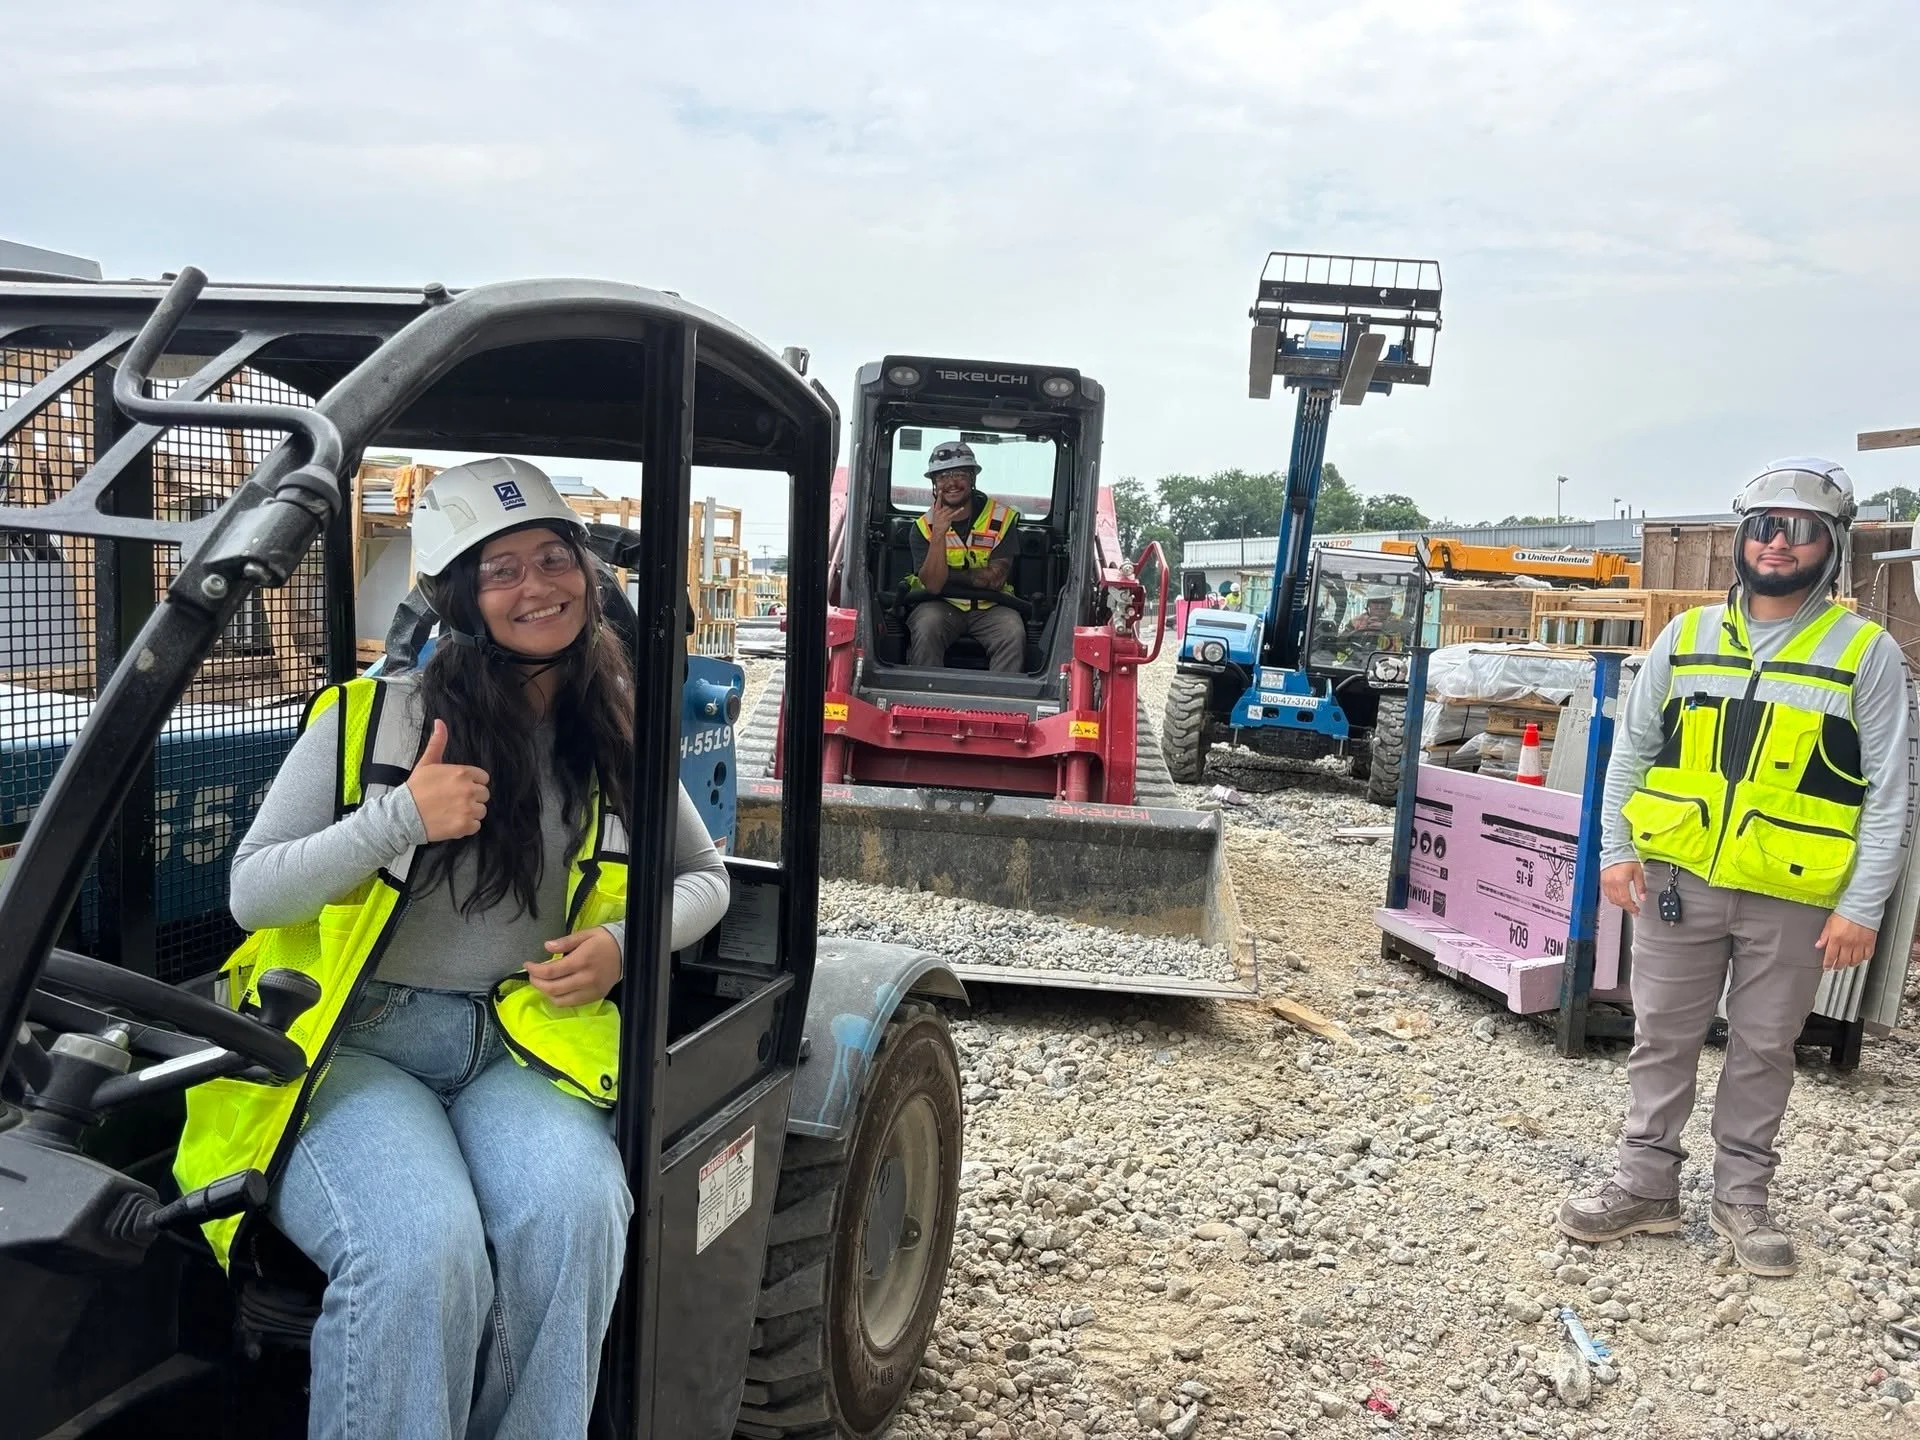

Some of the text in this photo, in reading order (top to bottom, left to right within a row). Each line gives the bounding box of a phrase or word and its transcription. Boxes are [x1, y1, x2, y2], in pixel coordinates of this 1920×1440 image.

[1527, 553, 1590, 564] United Rentals
[1509, 922, 1564, 957] NGX 604
